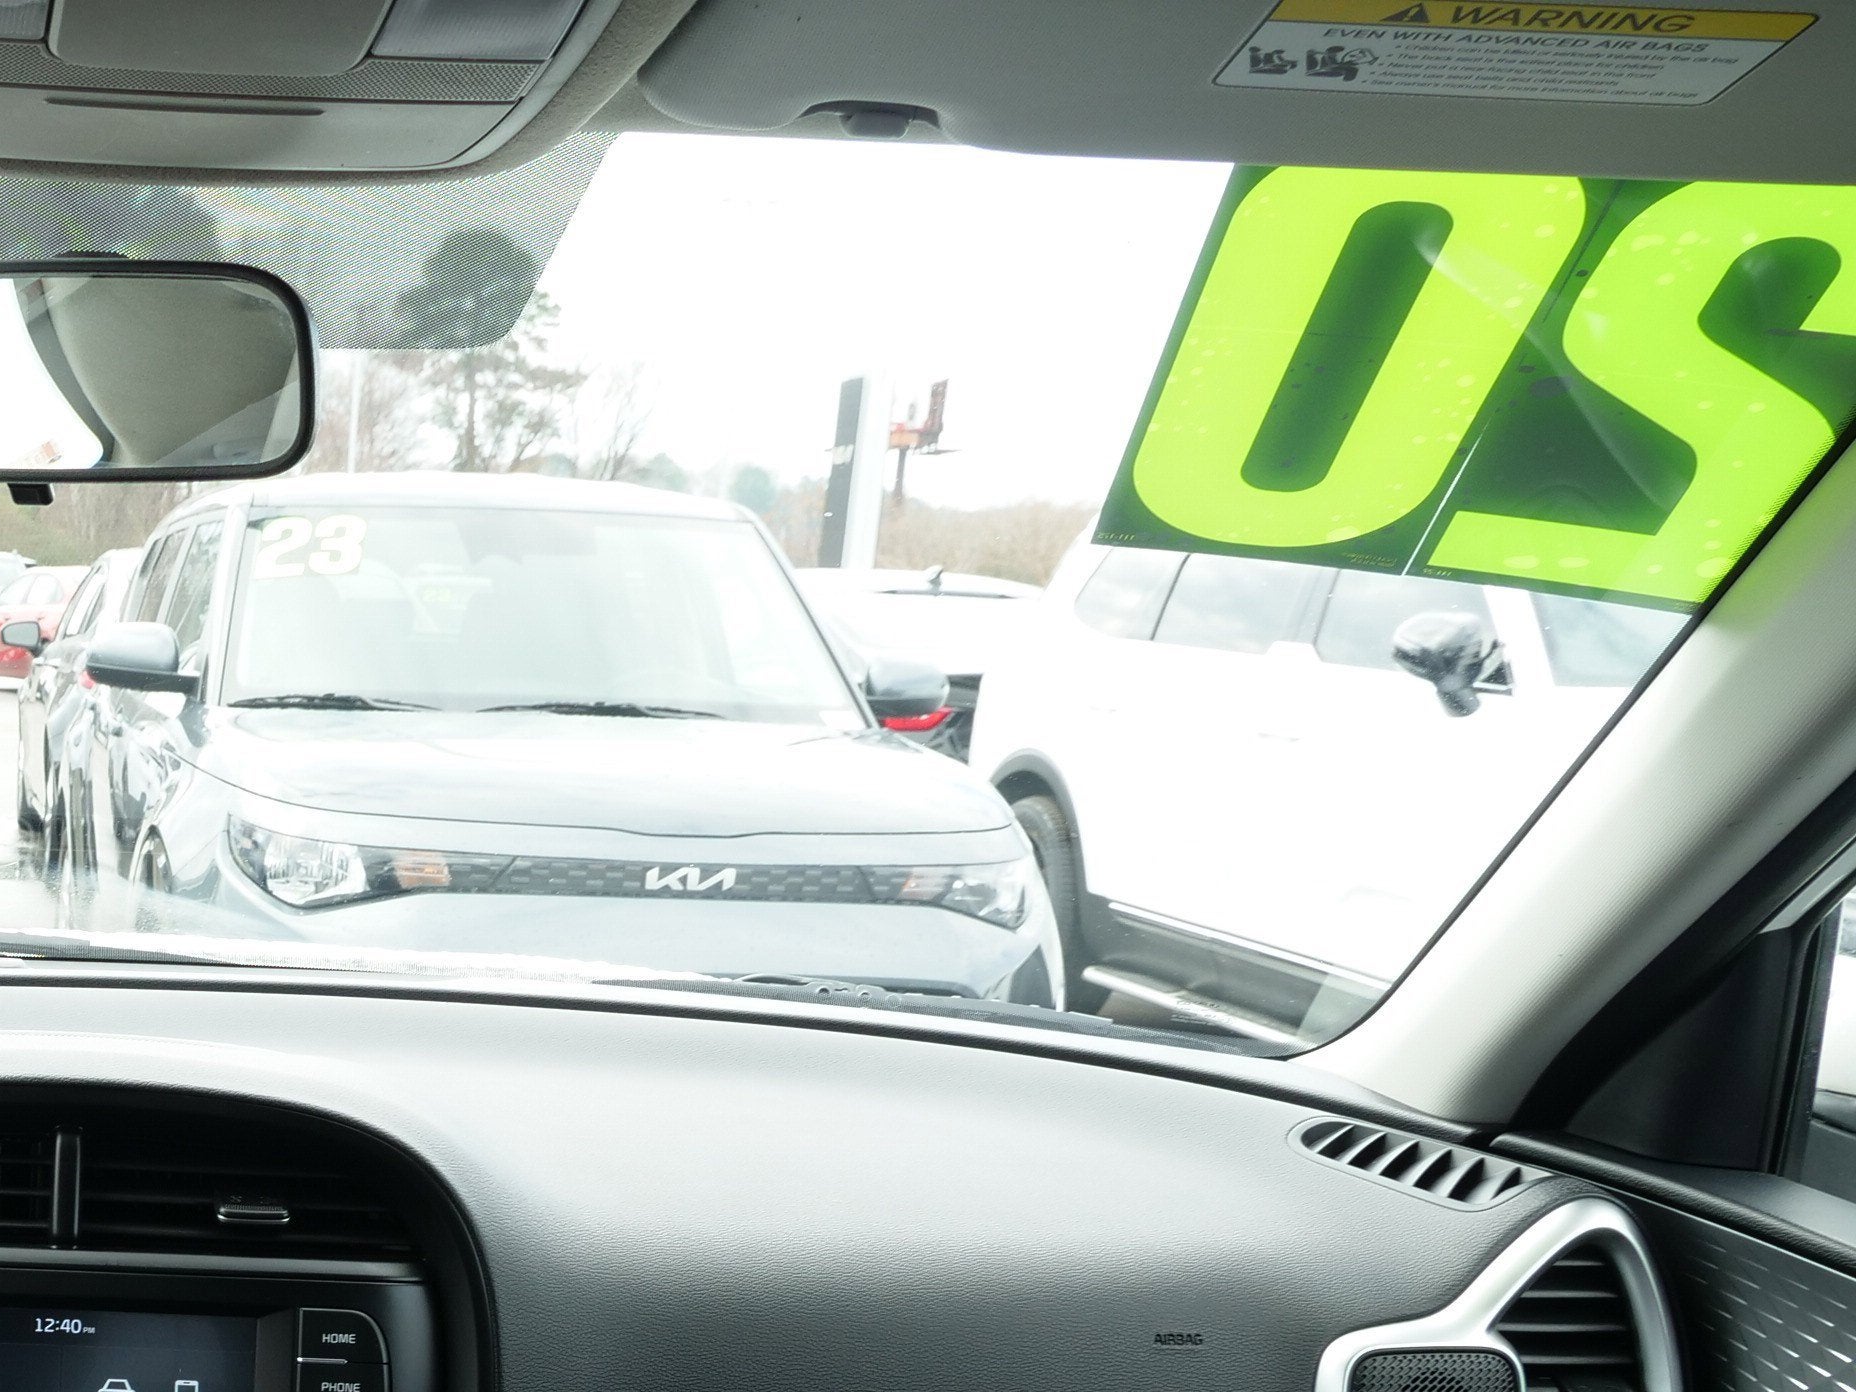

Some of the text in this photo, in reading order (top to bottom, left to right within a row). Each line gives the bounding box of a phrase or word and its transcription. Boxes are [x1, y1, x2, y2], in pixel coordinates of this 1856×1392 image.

[1451, 6, 1695, 33] WARNING
[1323, 28, 1710, 53] EVEN WITH ADVANCED AIR BAGS
[255, 514, 368, 580] 23
[322, 1333, 356, 1345] HOME
[1154, 1333, 1203, 1346] AIRBAG
